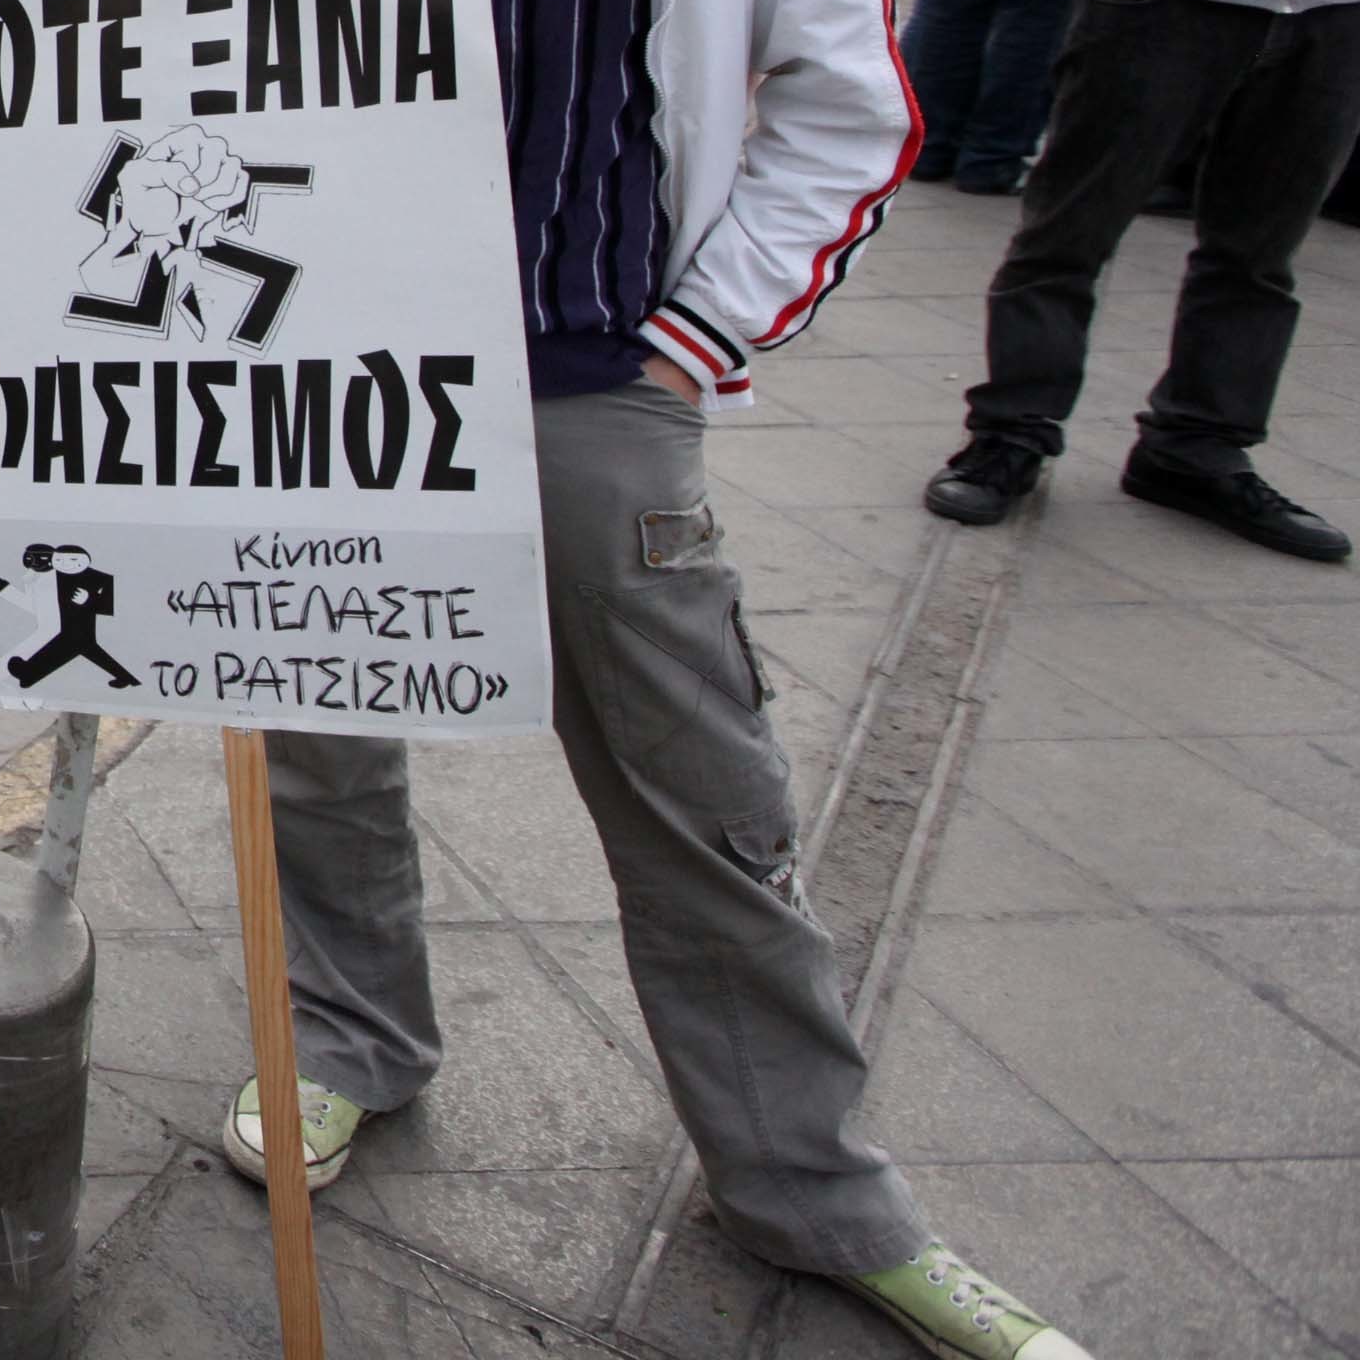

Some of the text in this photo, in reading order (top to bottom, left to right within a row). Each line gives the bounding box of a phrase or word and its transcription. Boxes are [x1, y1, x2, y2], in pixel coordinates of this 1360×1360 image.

[233, 531, 383, 572] Κίνηση
[166, 580, 485, 641] «ΑΠΕΛΑΣΤΕ
[214, 651, 510, 715] ΡΑΤΣΙΣΜΟ»
